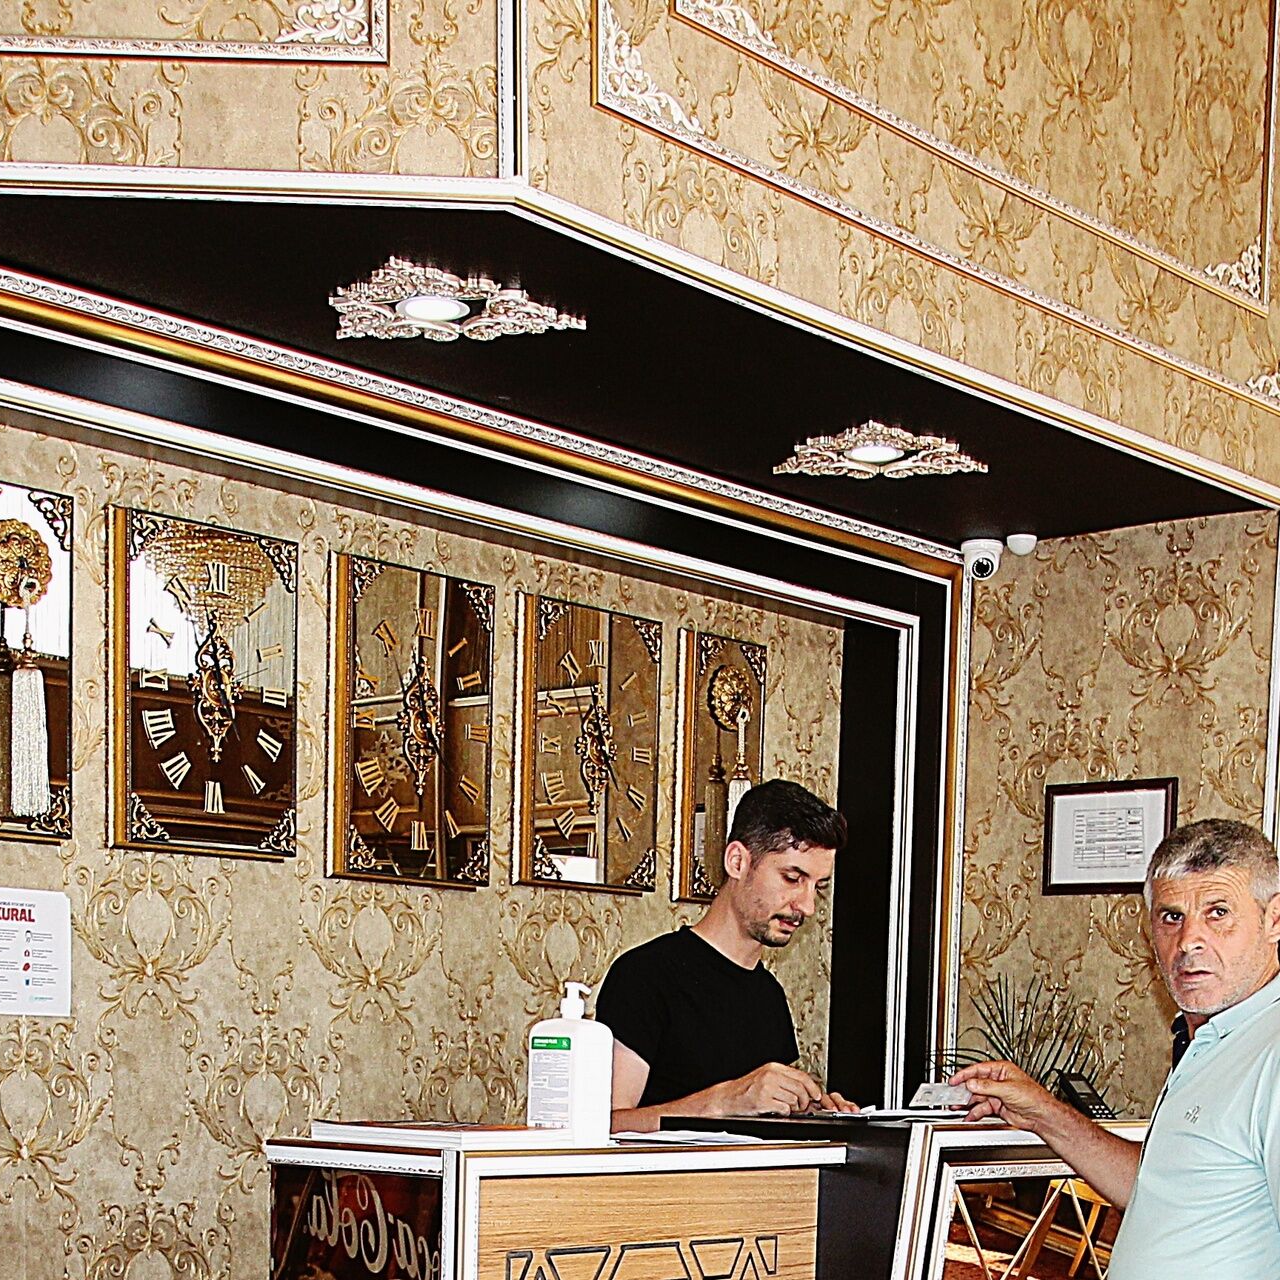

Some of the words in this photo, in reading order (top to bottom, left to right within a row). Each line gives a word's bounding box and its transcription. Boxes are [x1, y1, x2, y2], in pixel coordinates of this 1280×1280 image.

[164, 574, 192, 614] XI
[207, 561, 228, 595] XII
[146, 617, 175, 648] X
[414, 608, 435, 639] XII
[560, 650, 582, 685] XI
[587, 640, 606, 668] XII
[139, 668, 169, 691] IX
[261, 686, 287, 708] III
[142, 708, 177, 749] VIII
[257, 728, 282, 762] IV
[159, 751, 192, 790] VII
[355, 757, 385, 797] VIII
[459, 774, 481, 804] IV
[374, 797, 401, 832] VII
